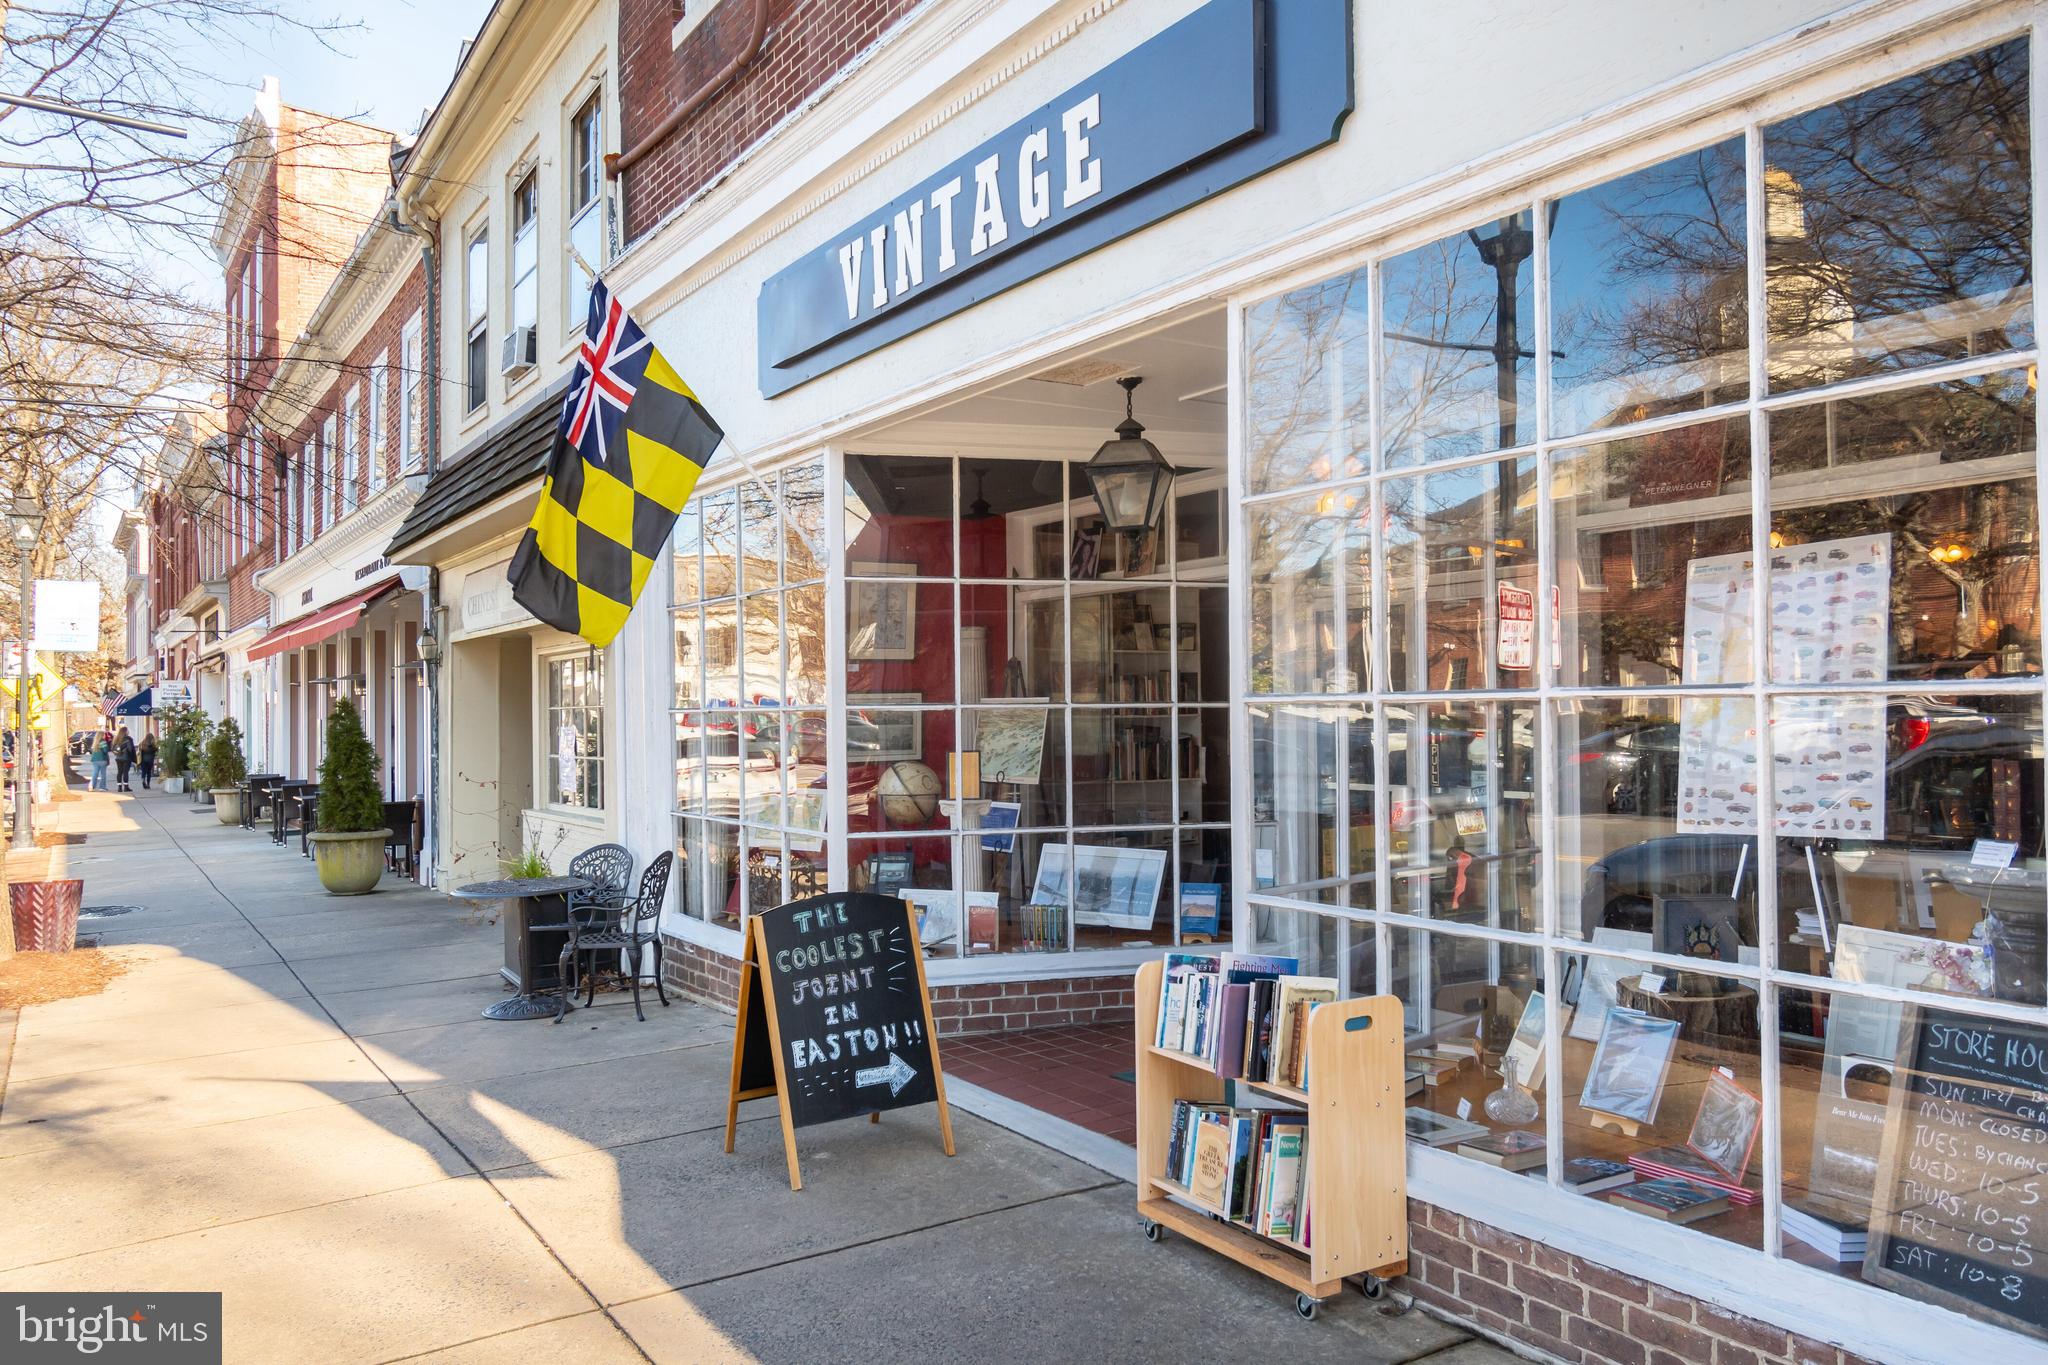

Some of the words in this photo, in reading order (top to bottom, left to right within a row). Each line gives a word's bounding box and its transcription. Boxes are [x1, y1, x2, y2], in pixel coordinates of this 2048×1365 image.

[839, 92, 1103, 320] VINTAGE
[792, 901, 849, 934] THE
[775, 928, 885, 973] COOLEST
[1233, 960, 1267, 973] Fighting
[792, 965, 875, 1006] JOINT
[824, 1001, 859, 1026] IN
[1928, 1023, 1996, 1064] STORE
[1280, 1140, 1296, 1150] New
[1979, 1118, 2047, 1145] CLOSED
[1979, 1172, 2040, 1205] 10-5
[1975, 1204, 2032, 1236] 10-5
[1967, 1232, 2033, 1267] 10-5
[1959, 1262, 2023, 1301] 10-8
